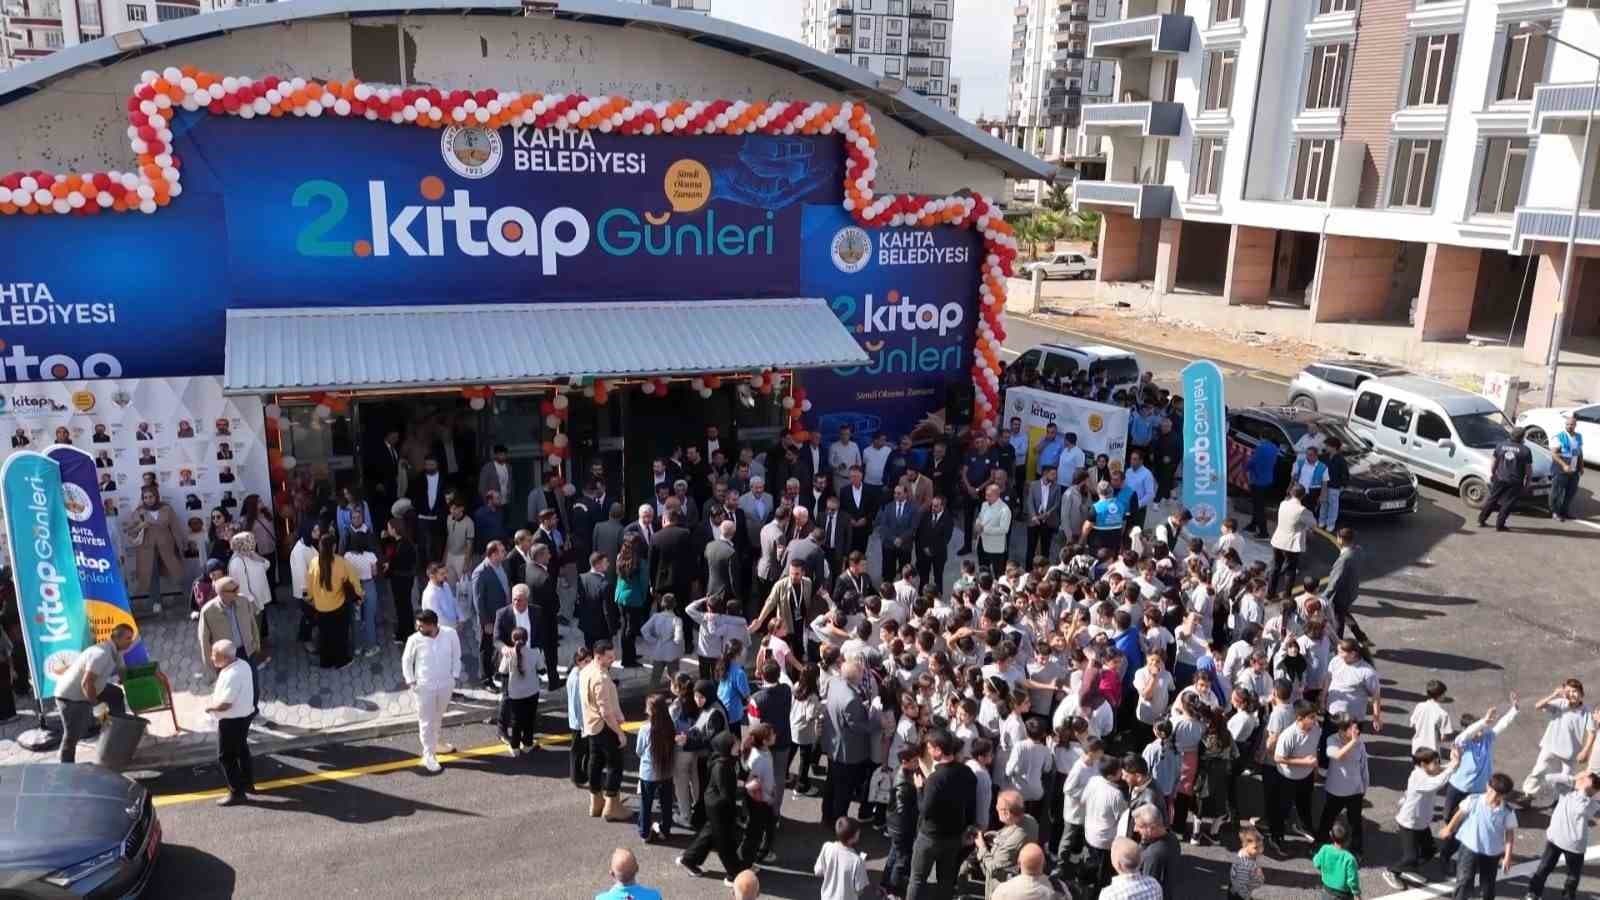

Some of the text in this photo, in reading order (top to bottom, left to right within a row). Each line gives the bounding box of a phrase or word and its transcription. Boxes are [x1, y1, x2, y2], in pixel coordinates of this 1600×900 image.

[513, 127, 596, 150] KAHTA
[879, 231, 936, 249] KAHTA
[0, 283, 55, 304] HTA
[0, 303, 116, 326] LEDİYESİ
[75, 550, 111, 573] itap
[34, 561, 73, 643] kitap
